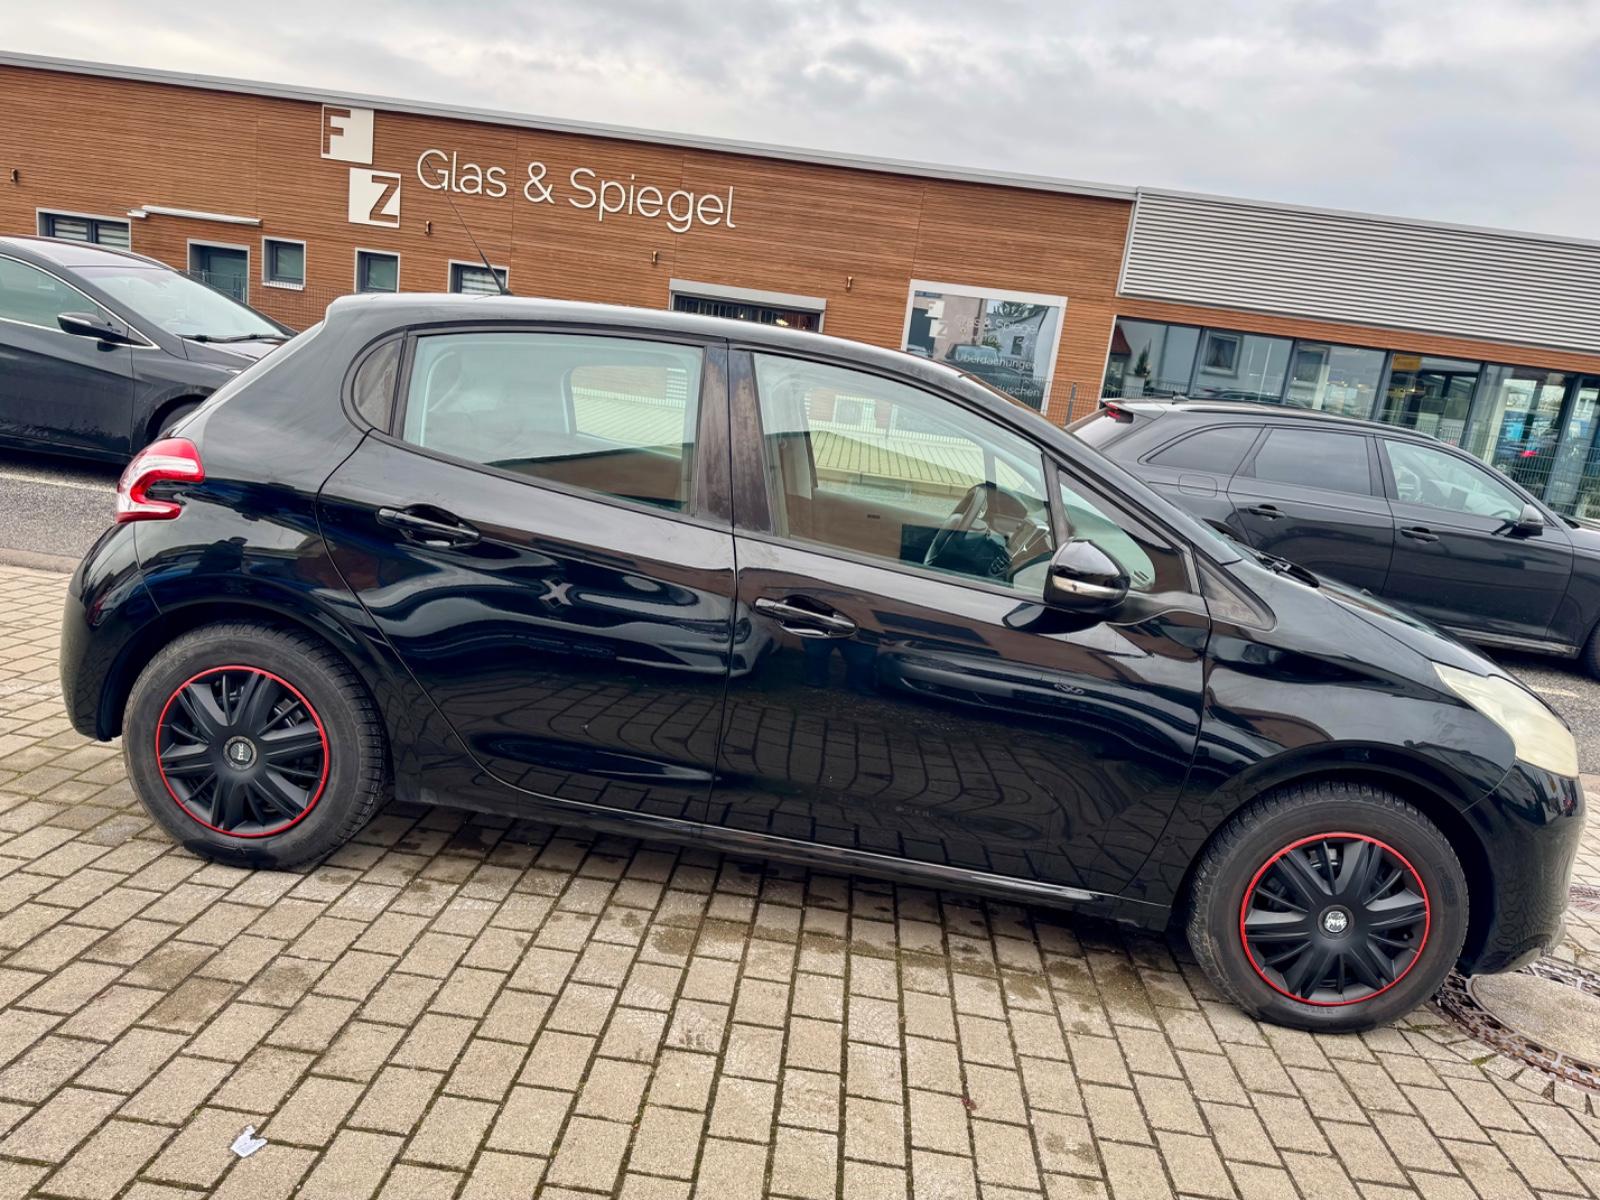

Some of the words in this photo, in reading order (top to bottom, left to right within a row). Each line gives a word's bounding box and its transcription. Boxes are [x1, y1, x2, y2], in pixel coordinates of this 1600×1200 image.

[322, 106, 352, 155] F
[368, 174, 401, 224] Z
[416, 149, 508, 198] Glas
[523, 162, 555, 205] &
[568, 167, 736, 233] Spiegel
